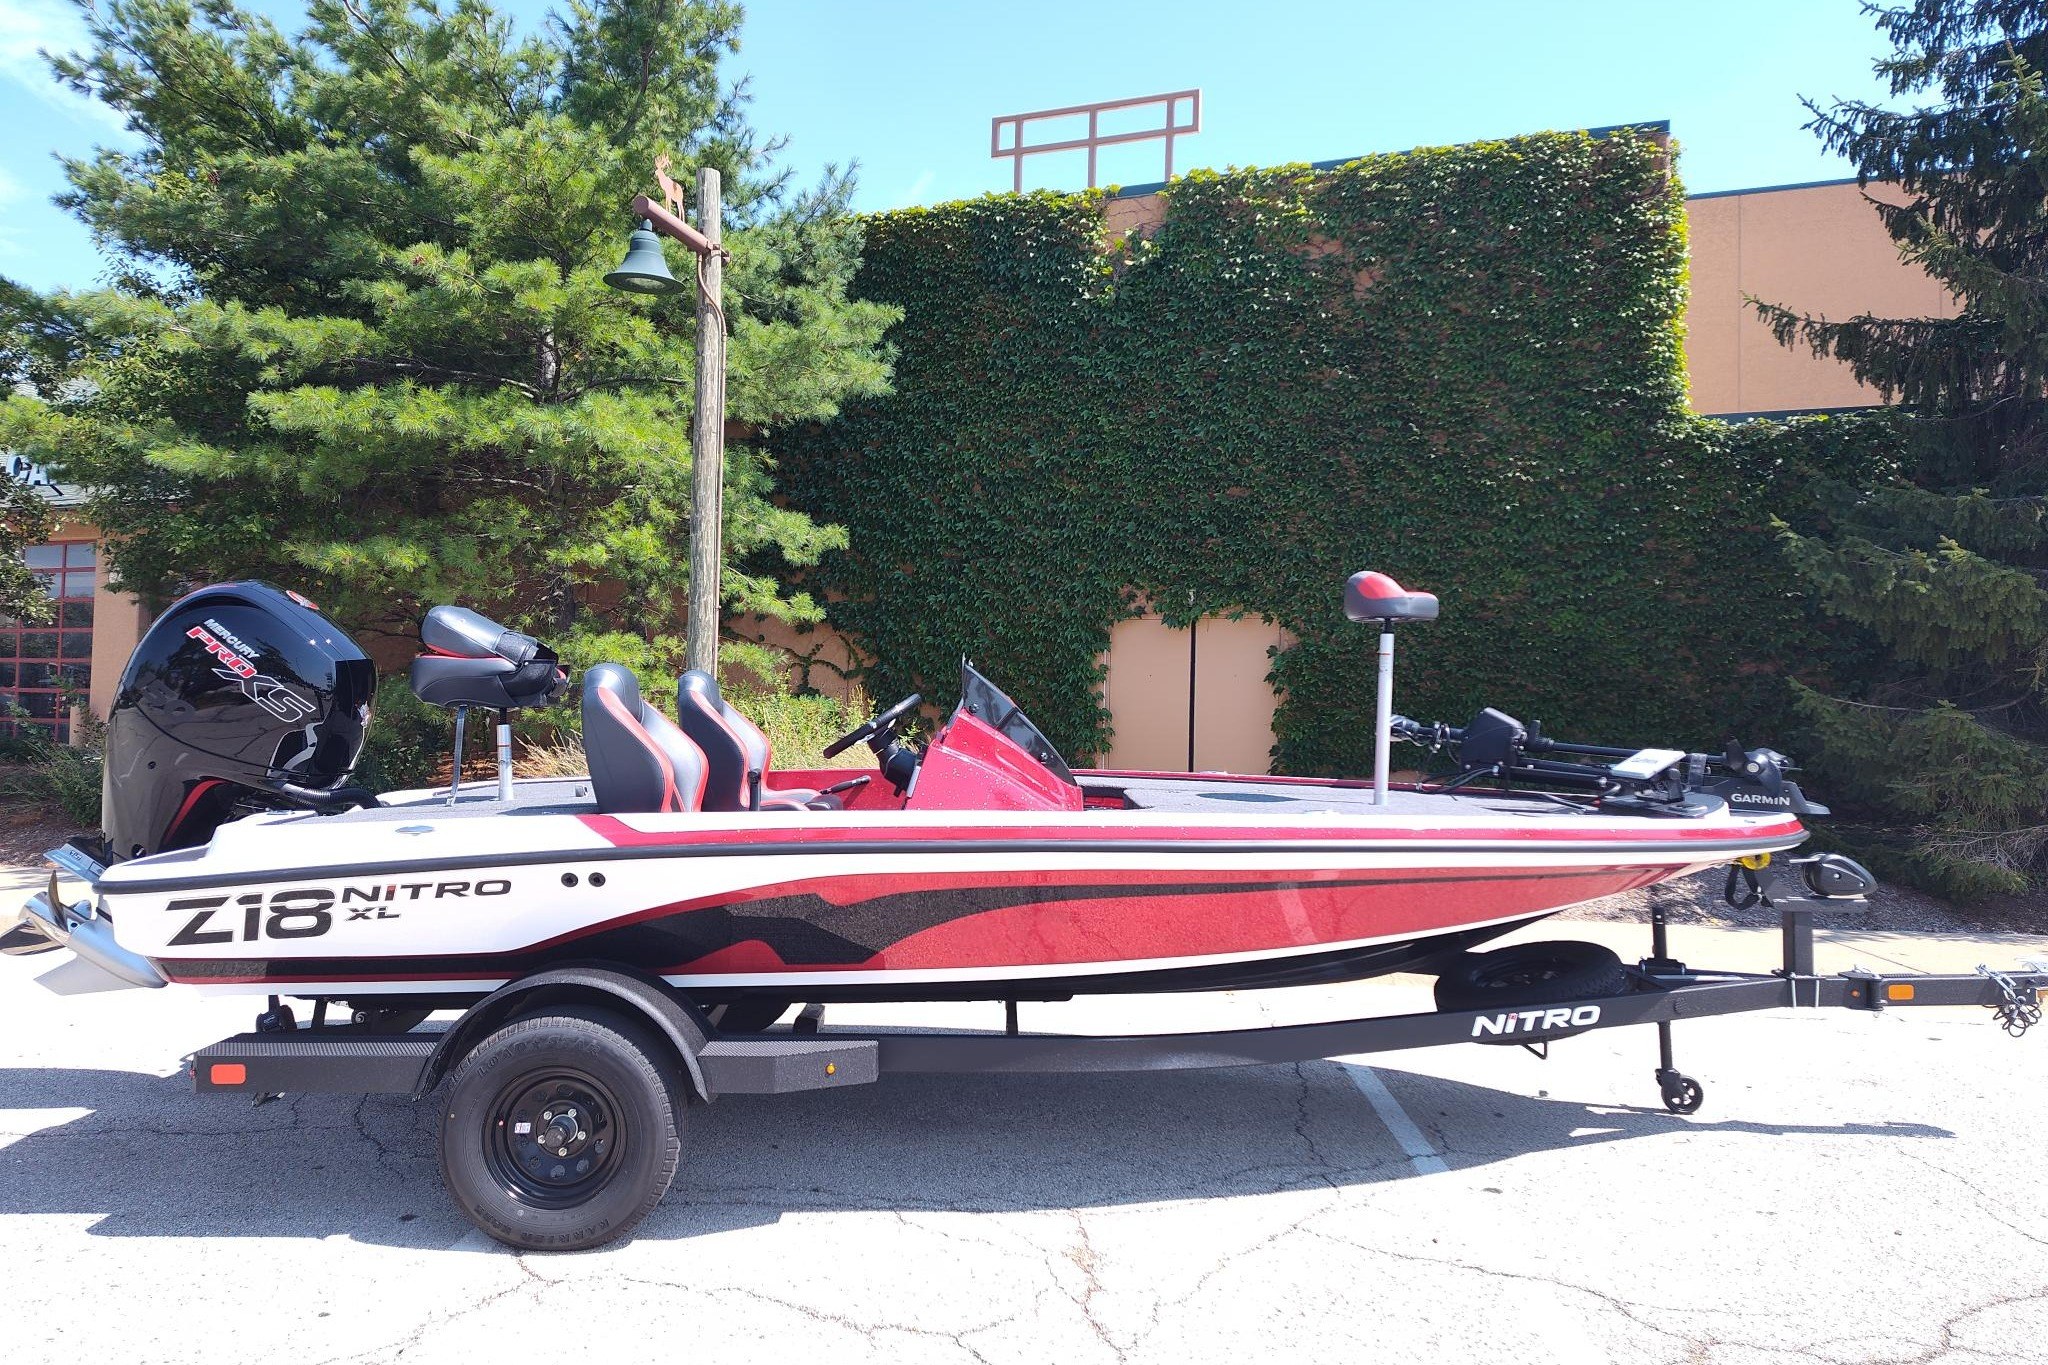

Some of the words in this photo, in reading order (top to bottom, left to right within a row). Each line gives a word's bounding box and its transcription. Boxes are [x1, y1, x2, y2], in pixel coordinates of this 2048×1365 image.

[186, 625, 257, 679] PRO
[203, 618, 260, 659] MERCURY
[211, 667, 317, 723] XS
[1730, 793, 1790, 806] GARMIN
[341, 879, 512, 903] NITRO
[164, 886, 337, 947] Z18
[345, 906, 401, 921] XL
[1471, 1005, 1601, 1037] NITRO
